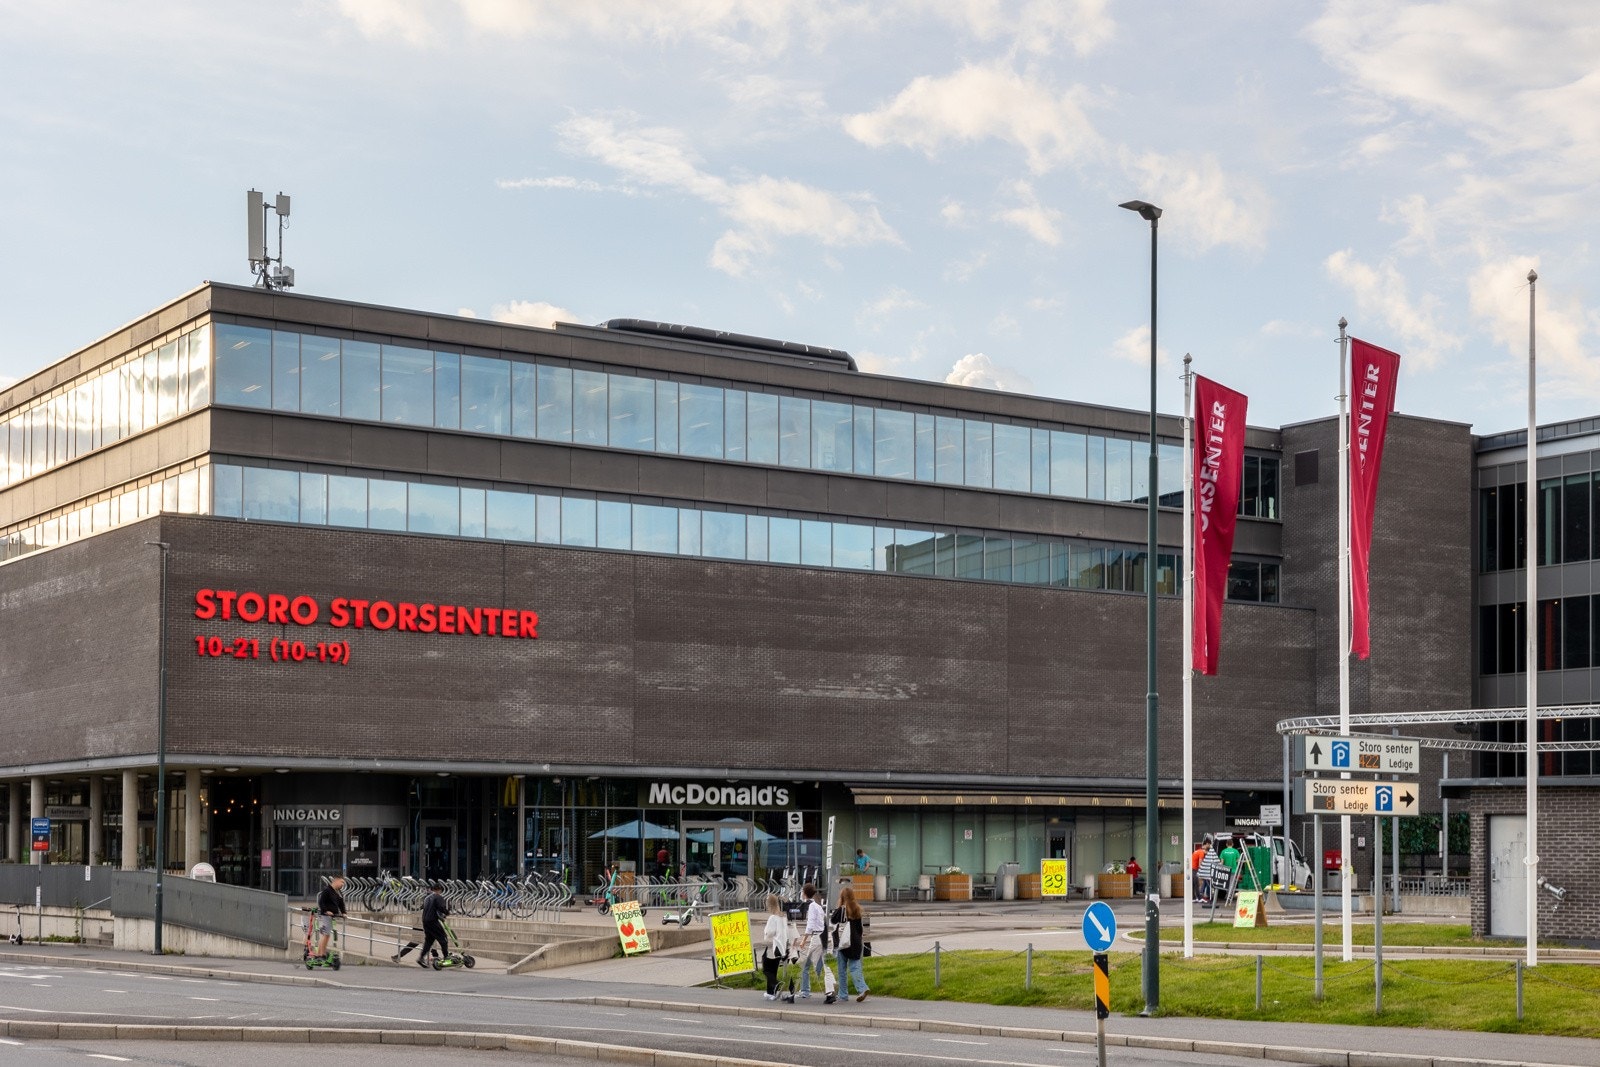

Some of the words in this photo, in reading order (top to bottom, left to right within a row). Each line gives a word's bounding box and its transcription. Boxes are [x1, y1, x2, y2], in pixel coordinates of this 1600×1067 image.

[195, 588, 319, 626] STORO
[329, 597, 540, 638] STORSENTER
[195, 635, 260, 659] 10-21
[270, 637, 351, 665] (10-19)
[1359, 741, 1382, 753] Storo
[1385, 744, 1413, 754] senter
[1389, 759, 1414, 771] Ledige
[648, 783, 789, 806] McDonald's
[1313, 782, 1336, 794] Storo
[1340, 785, 1368, 795] senter
[1343, 800, 1369, 812] Ledige
[273, 809, 341, 821] INNGANG
